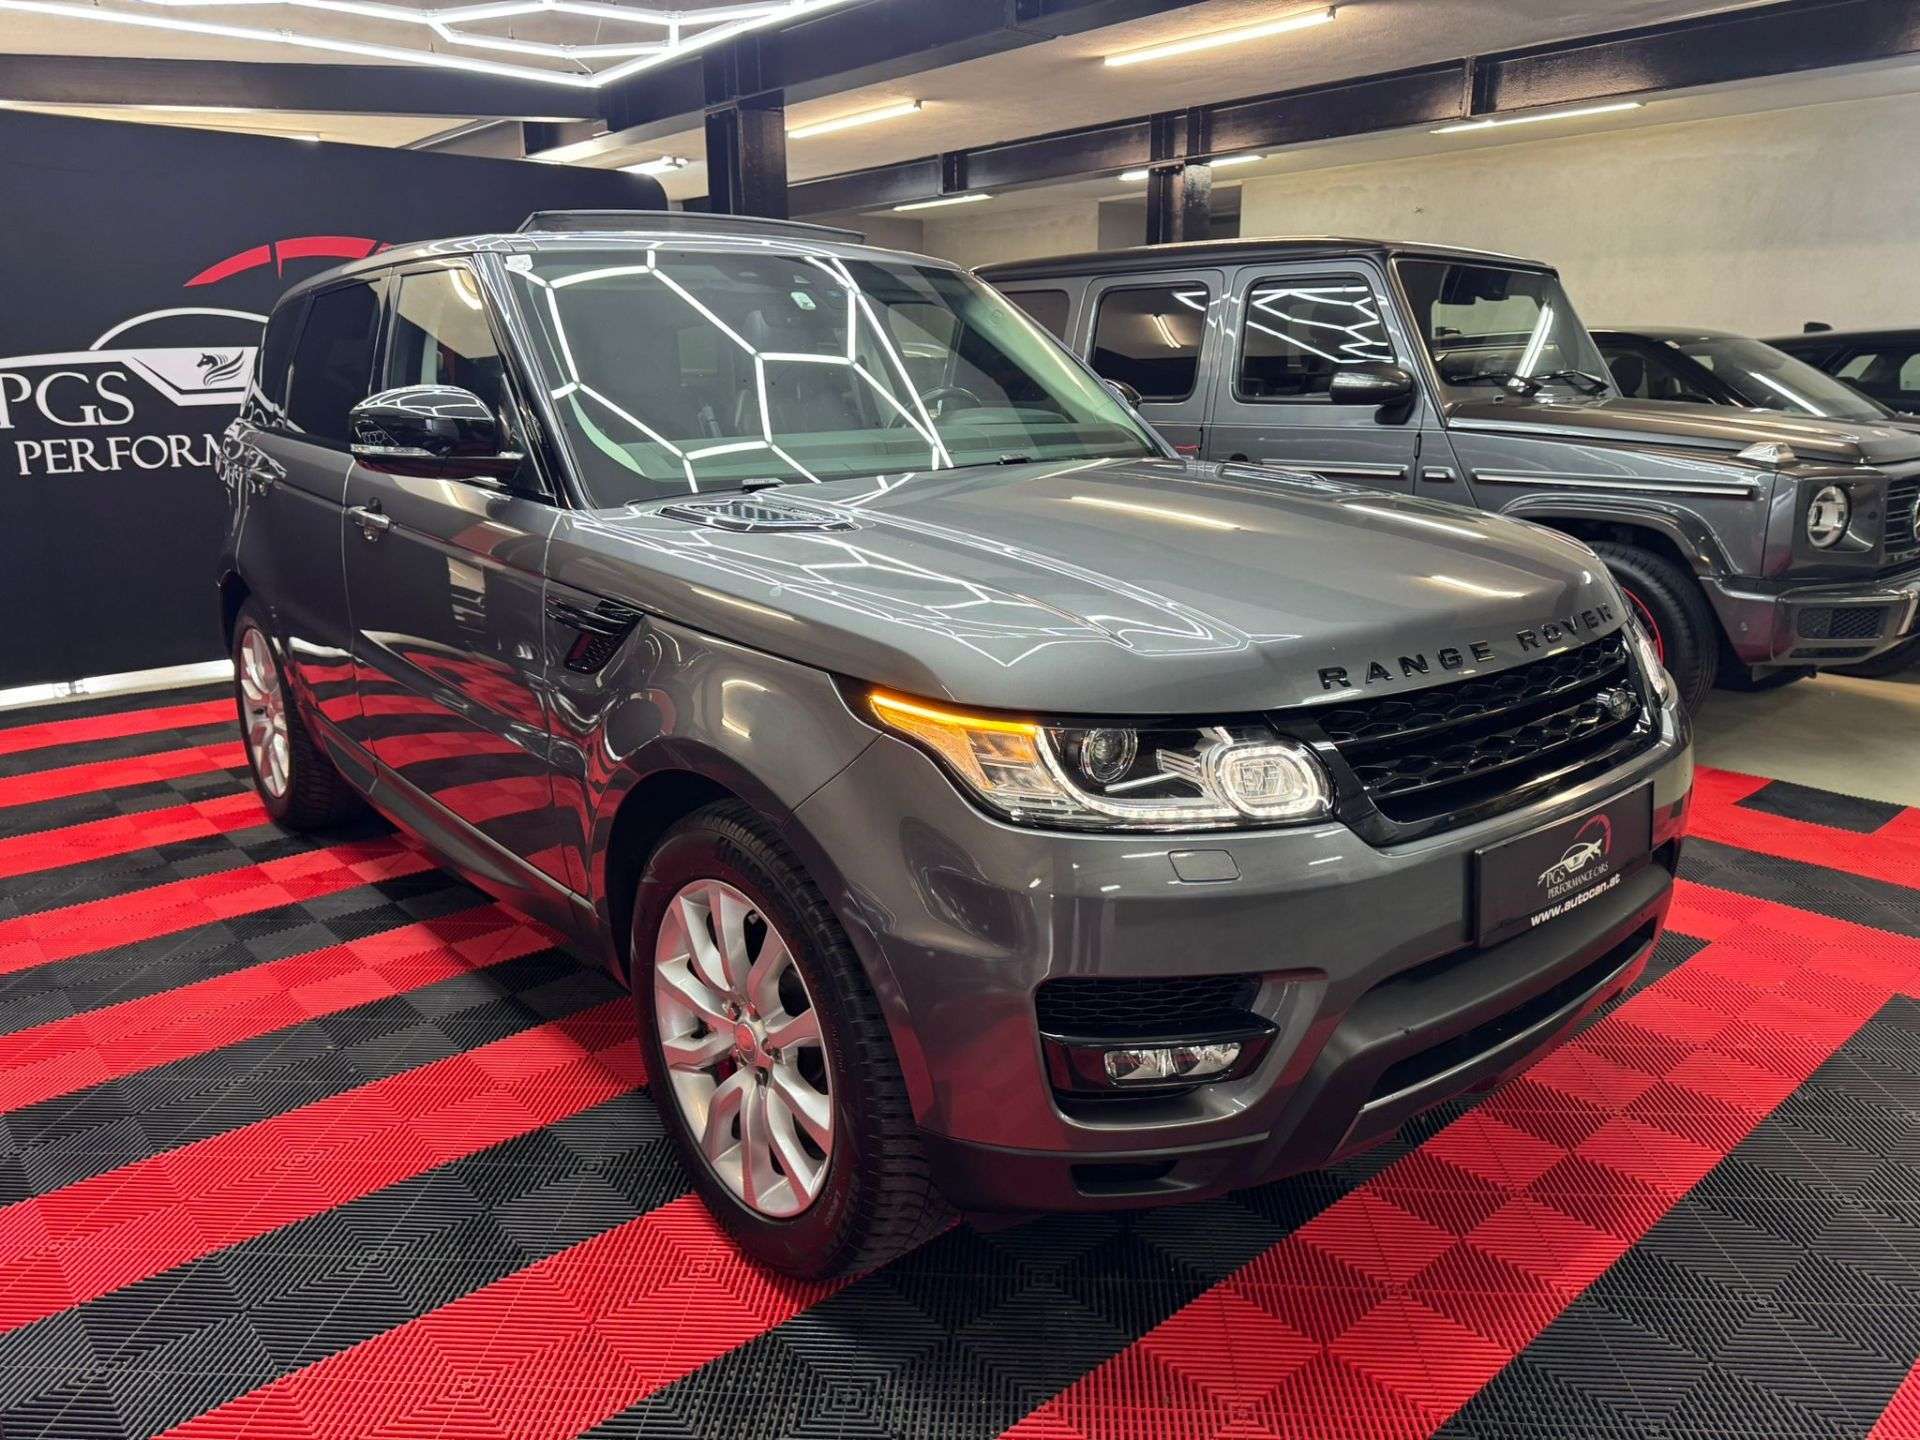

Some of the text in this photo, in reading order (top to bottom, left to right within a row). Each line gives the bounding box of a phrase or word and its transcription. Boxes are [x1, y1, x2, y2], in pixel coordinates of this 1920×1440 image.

[0, 371, 135, 429] PGS
[1317, 602, 1614, 690] RANGE ROVER
[1545, 866, 1566, 888] PGS
[1547, 862, 1609, 899] PERFORMANCE CARS
